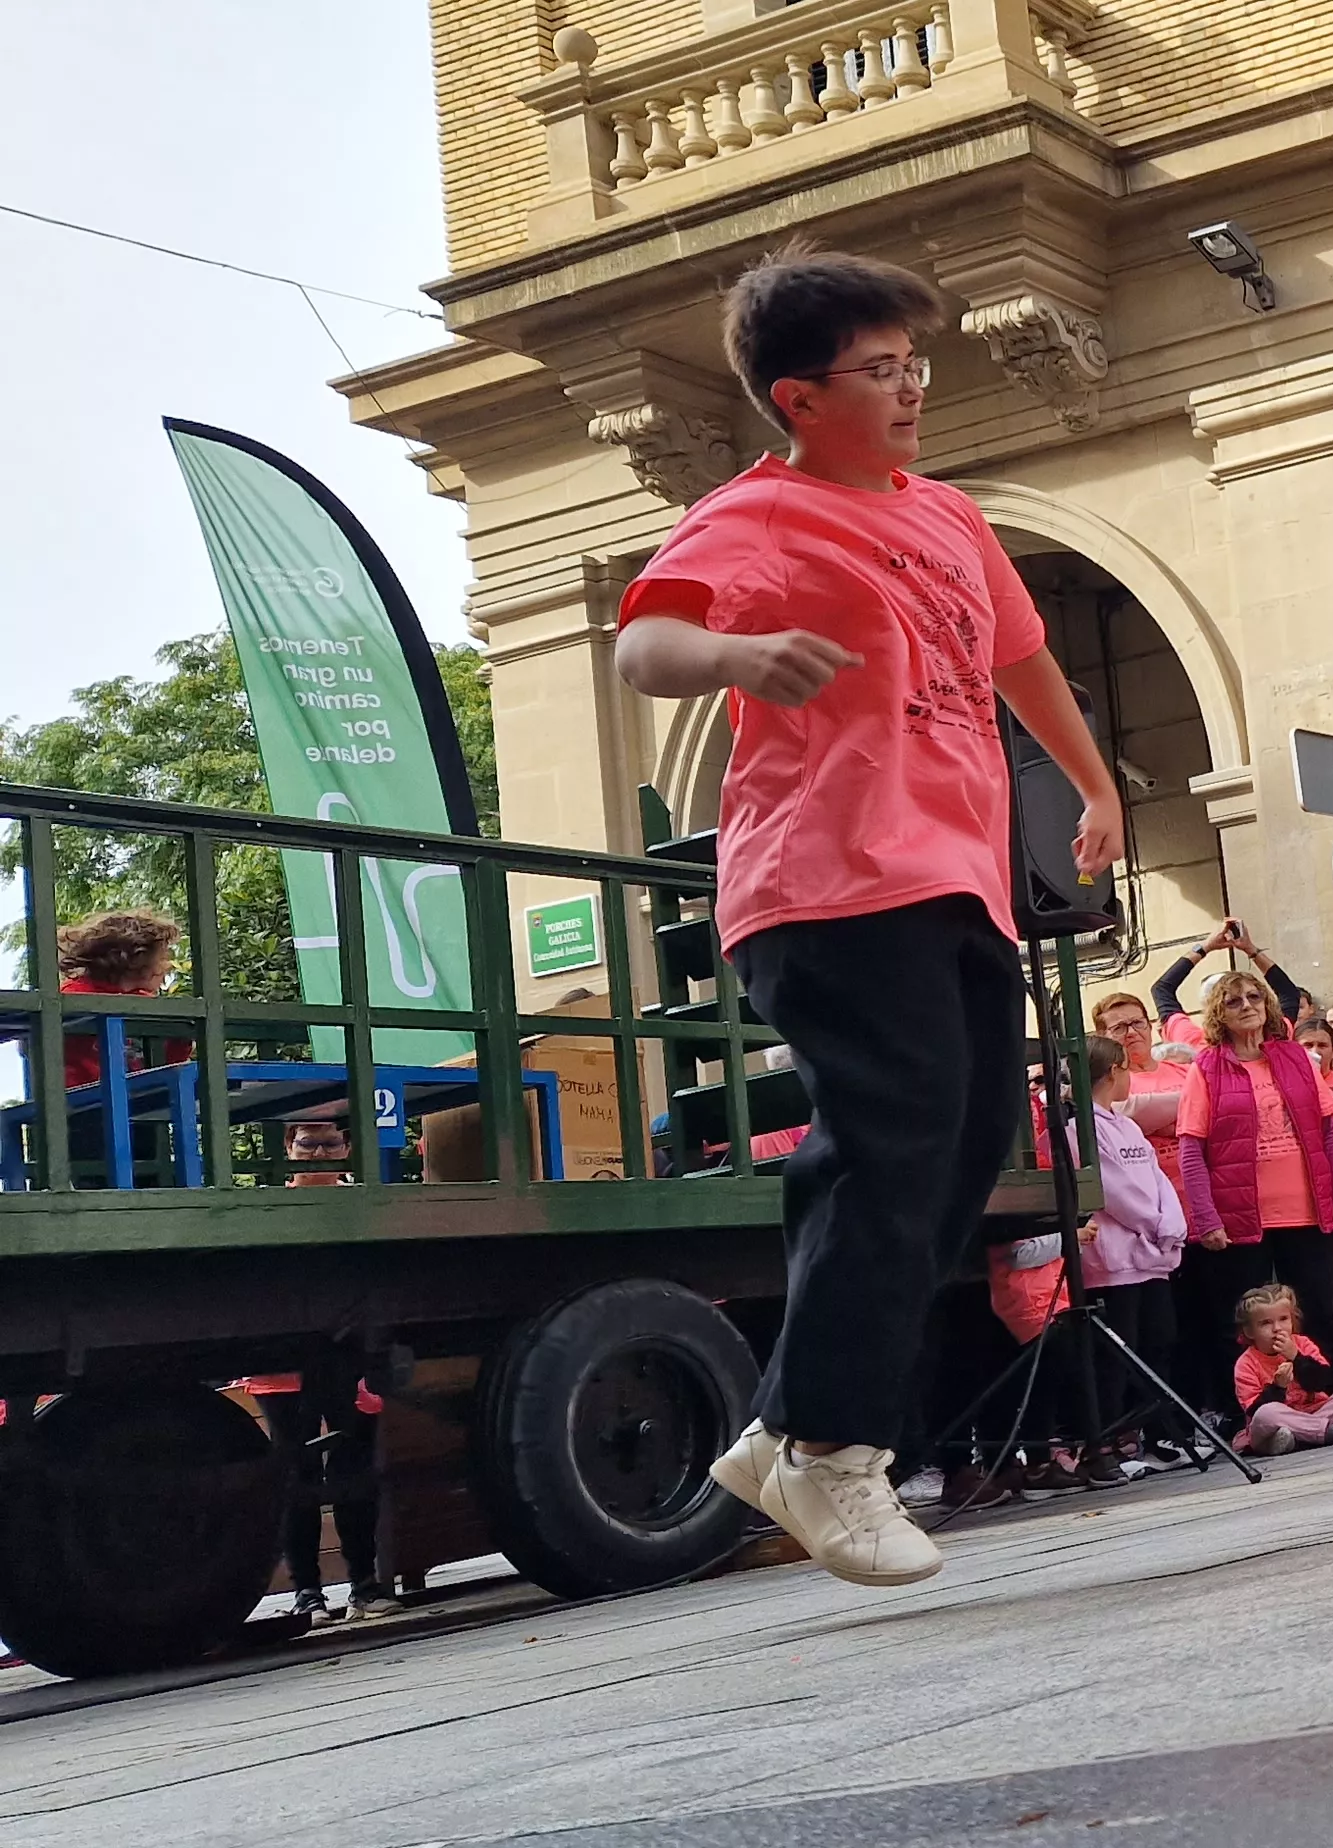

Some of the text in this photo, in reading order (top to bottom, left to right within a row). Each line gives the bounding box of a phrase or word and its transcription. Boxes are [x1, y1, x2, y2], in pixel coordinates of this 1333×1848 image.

[545, 918, 583, 934] PORCHES
[548, 931, 581, 946] GALICIA
[375, 1088, 397, 1127] 2
